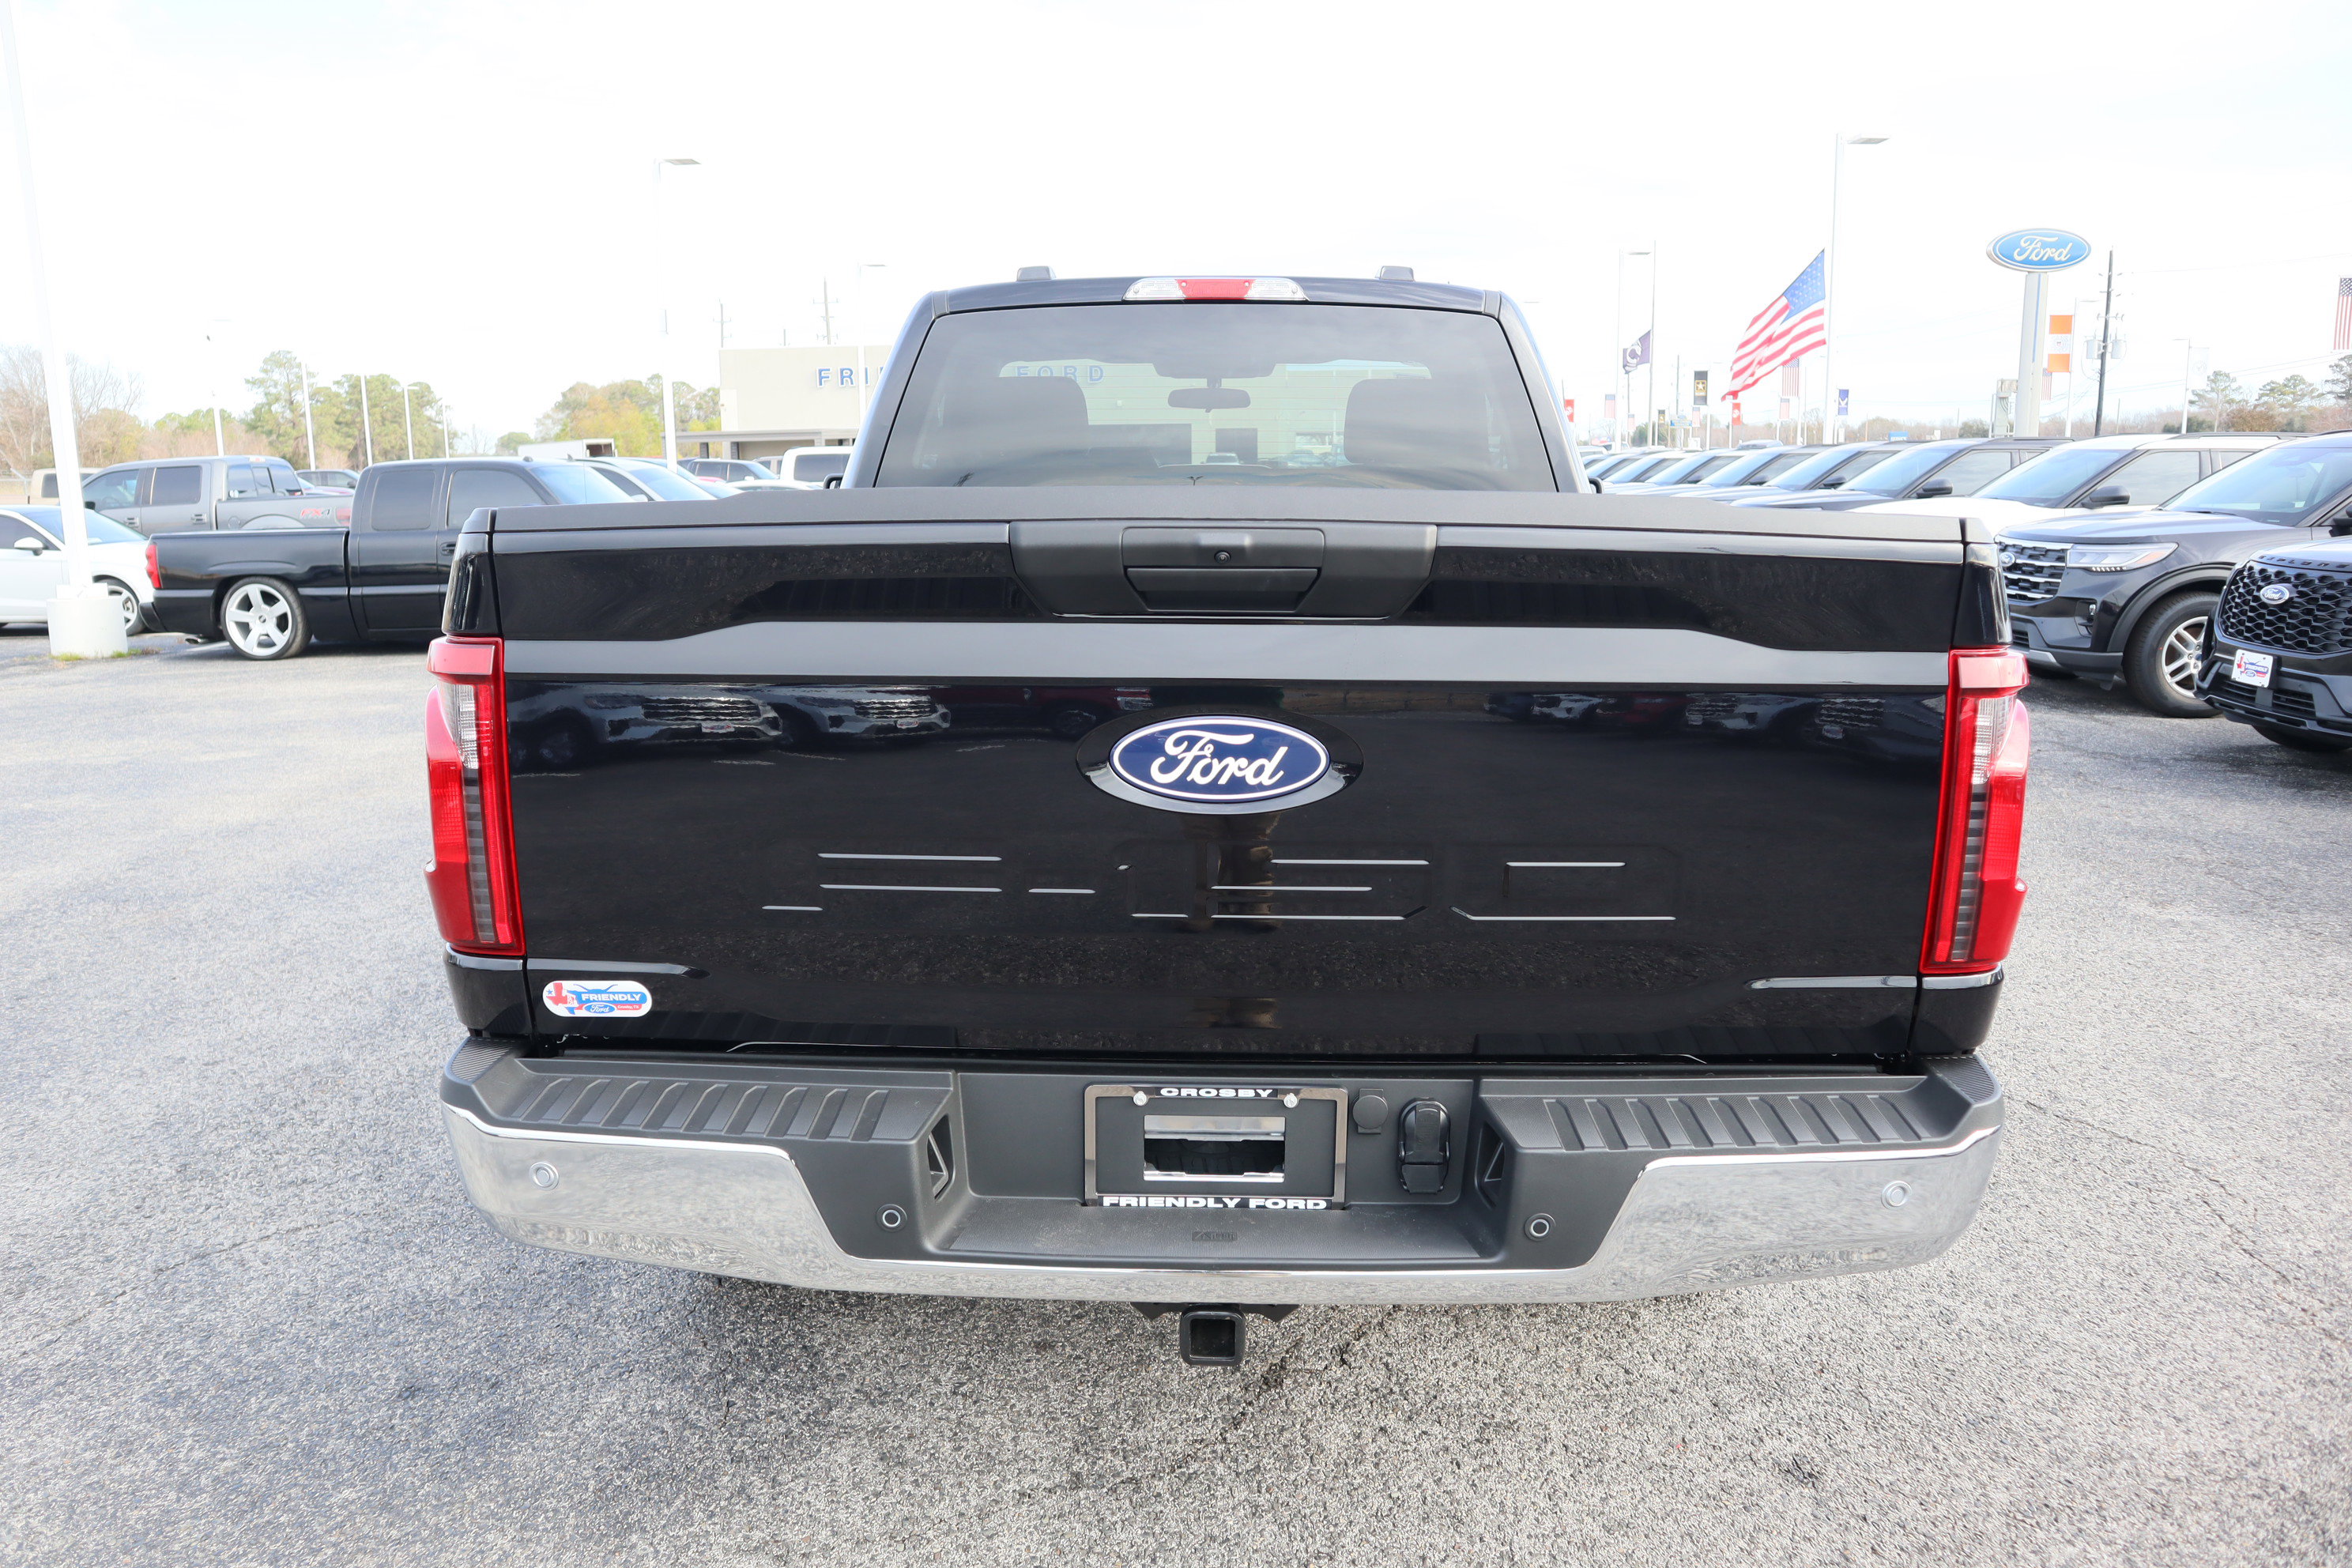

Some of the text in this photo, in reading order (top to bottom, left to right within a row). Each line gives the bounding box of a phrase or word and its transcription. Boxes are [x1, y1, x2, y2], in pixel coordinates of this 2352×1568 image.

[2013, 235, 2073, 262] Ford
[817, 365, 1104, 386] FRI FORD
[1149, 729, 1289, 786] Ford
[581, 993, 642, 1002] FRIENDLY
[590, 1004, 610, 1013] Ford
[1160, 1087, 1273, 1098] CROSBY
[1102, 1196, 1327, 1210] FRIENDLY FORD
